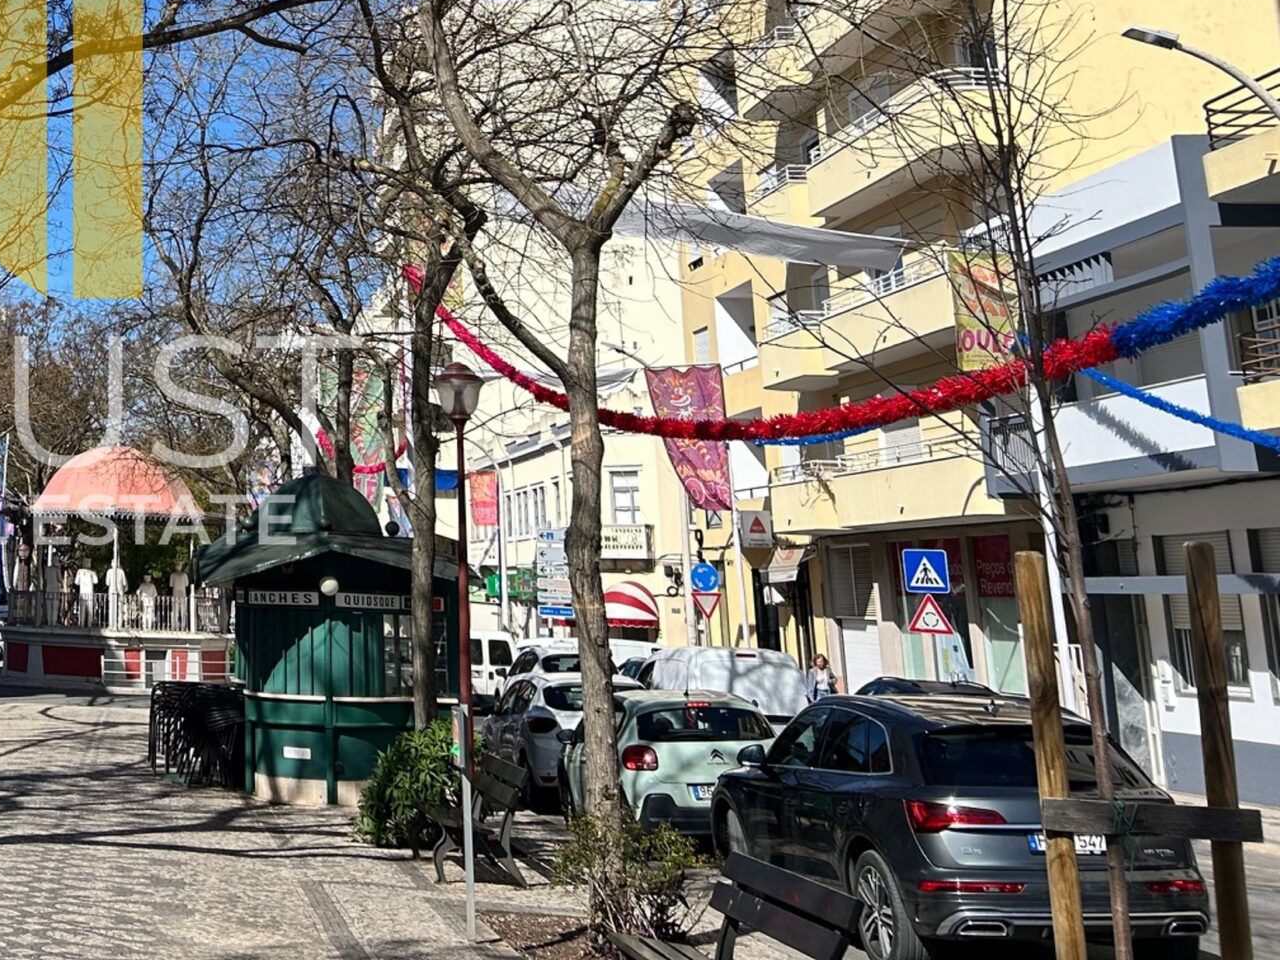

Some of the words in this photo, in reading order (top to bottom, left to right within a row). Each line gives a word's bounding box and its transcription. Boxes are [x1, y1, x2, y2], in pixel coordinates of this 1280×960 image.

[976, 560, 1006, 578] Preços
[980, 578, 1014, 594] Revend
[250, 591, 313, 604] LANCHES
[344, 595, 396, 607] QUIOSQUE
